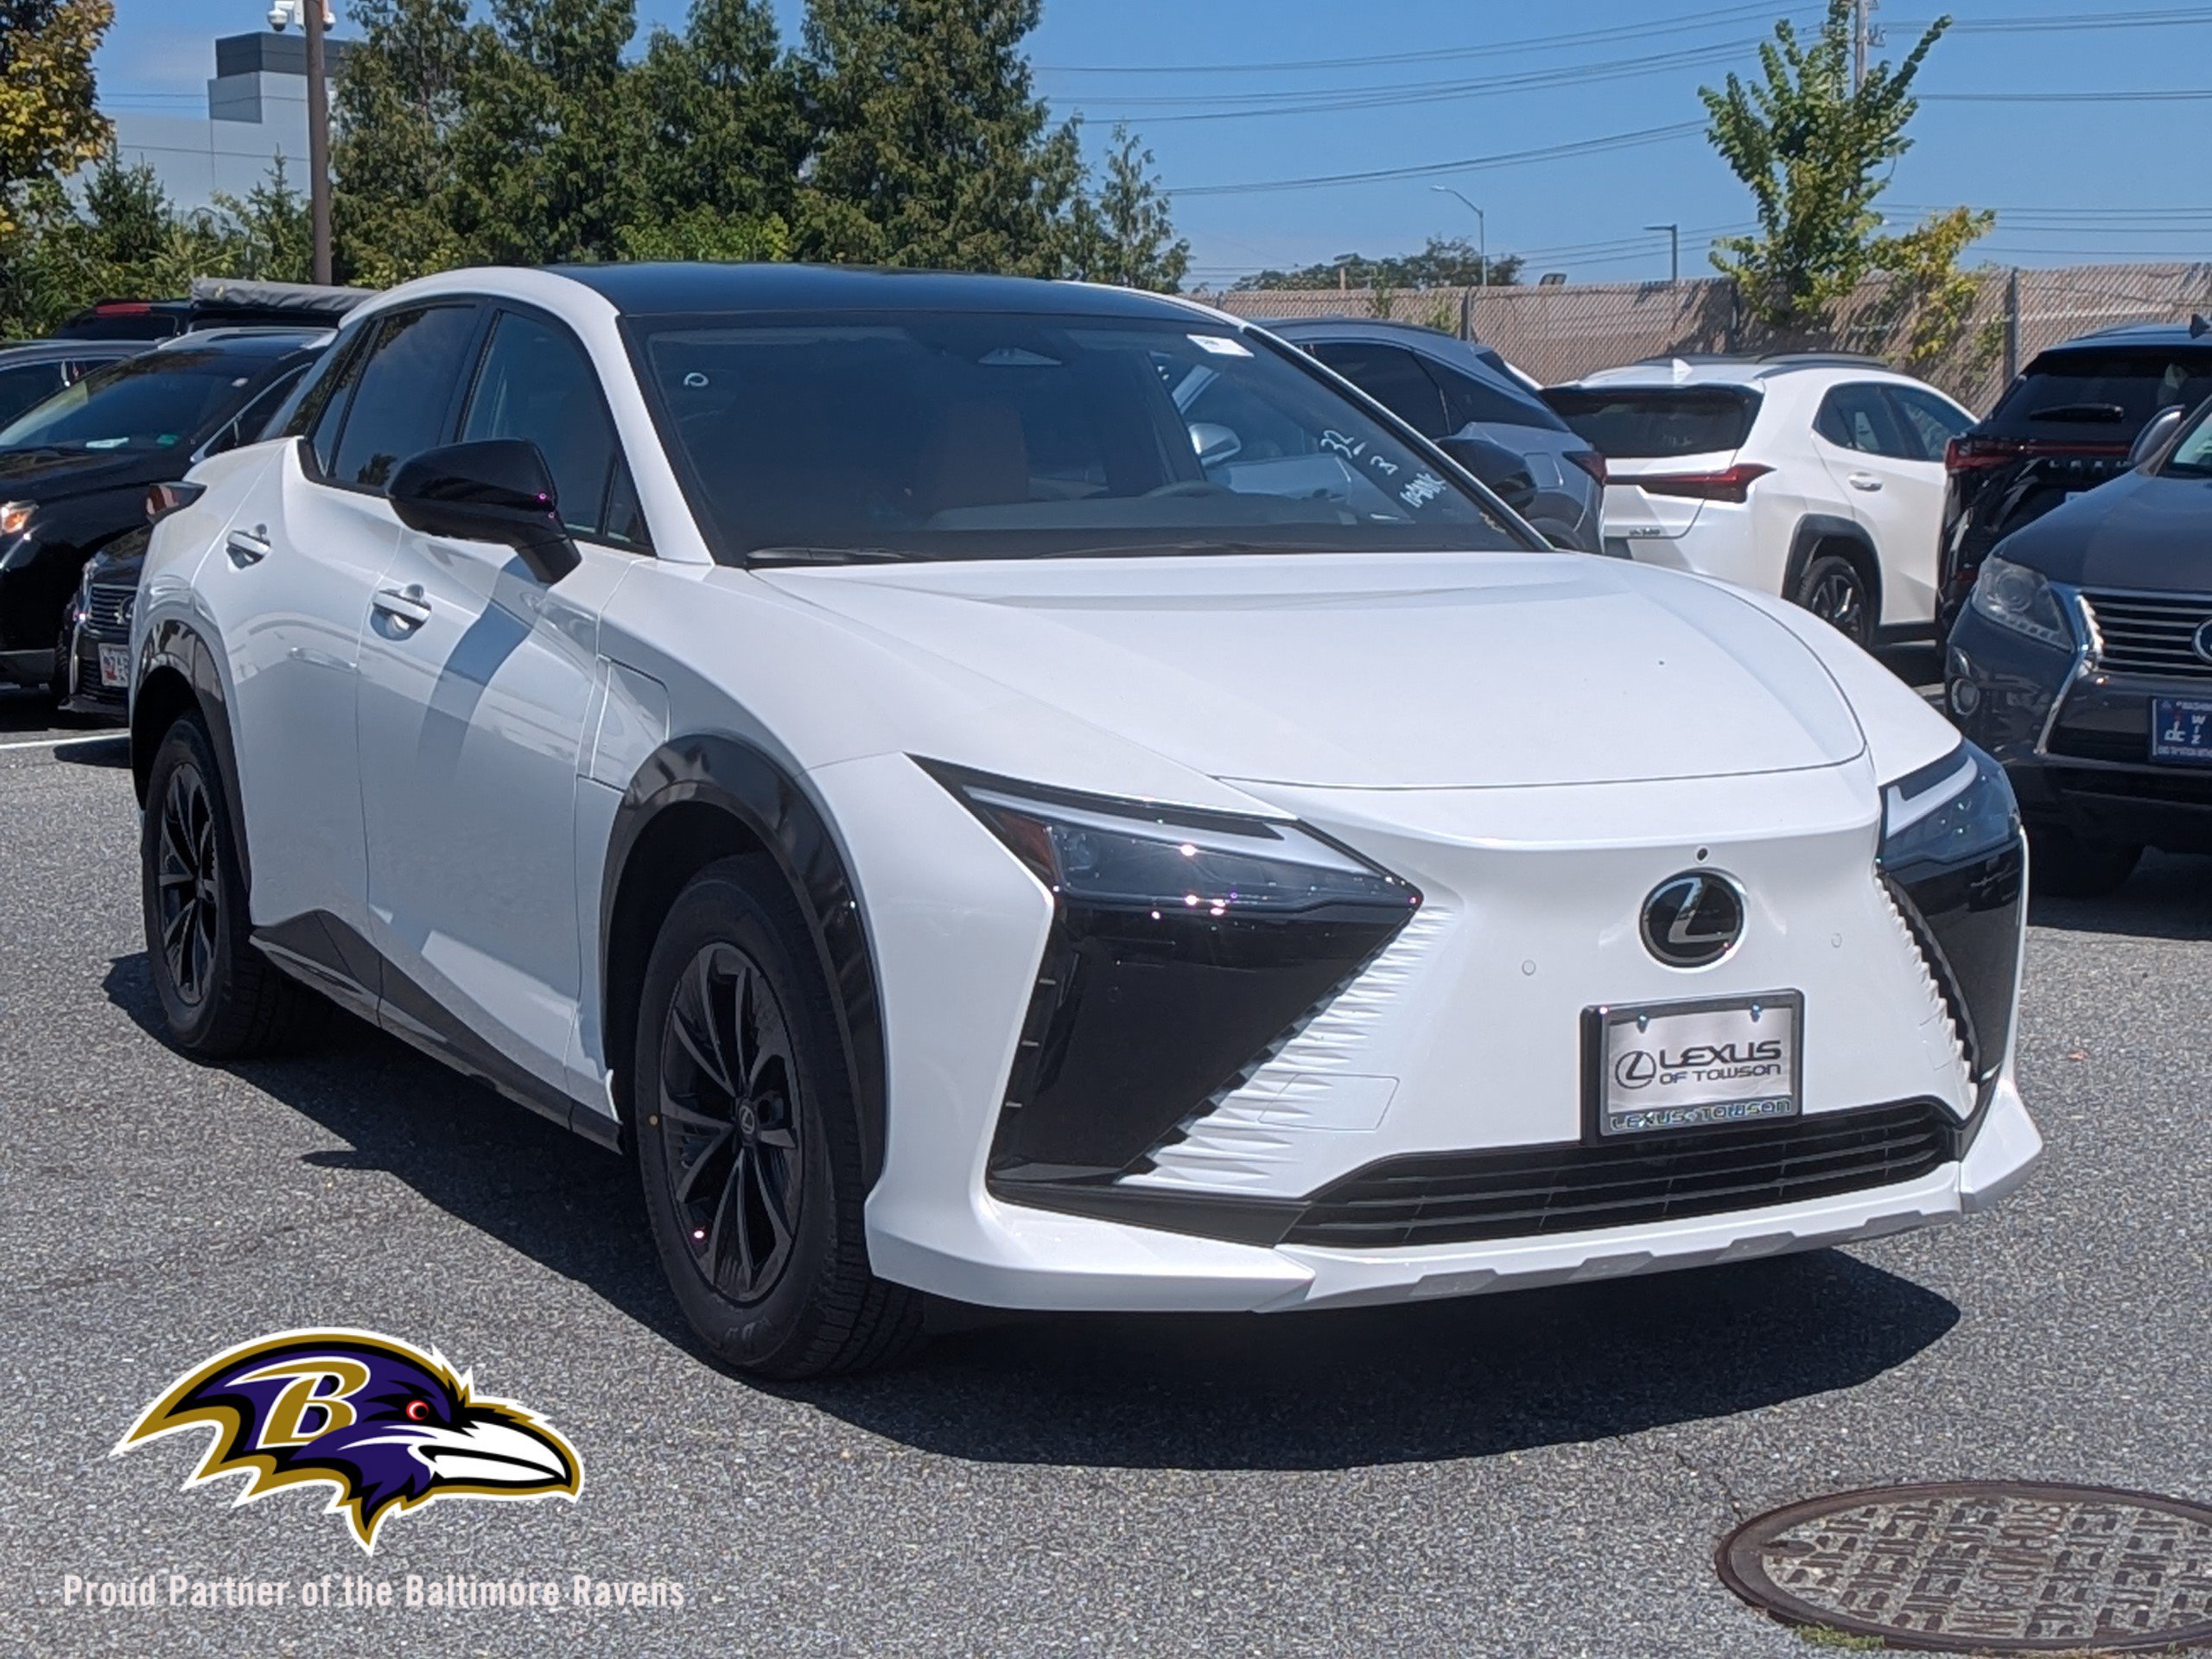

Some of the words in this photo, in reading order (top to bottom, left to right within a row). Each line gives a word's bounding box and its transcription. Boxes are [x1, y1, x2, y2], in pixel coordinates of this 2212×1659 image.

[1659, 1039, 1782, 1070] LEXUS
[1659, 1071, 1688, 1085] OF
[1610, 1110, 1686, 1131] LEXUS
